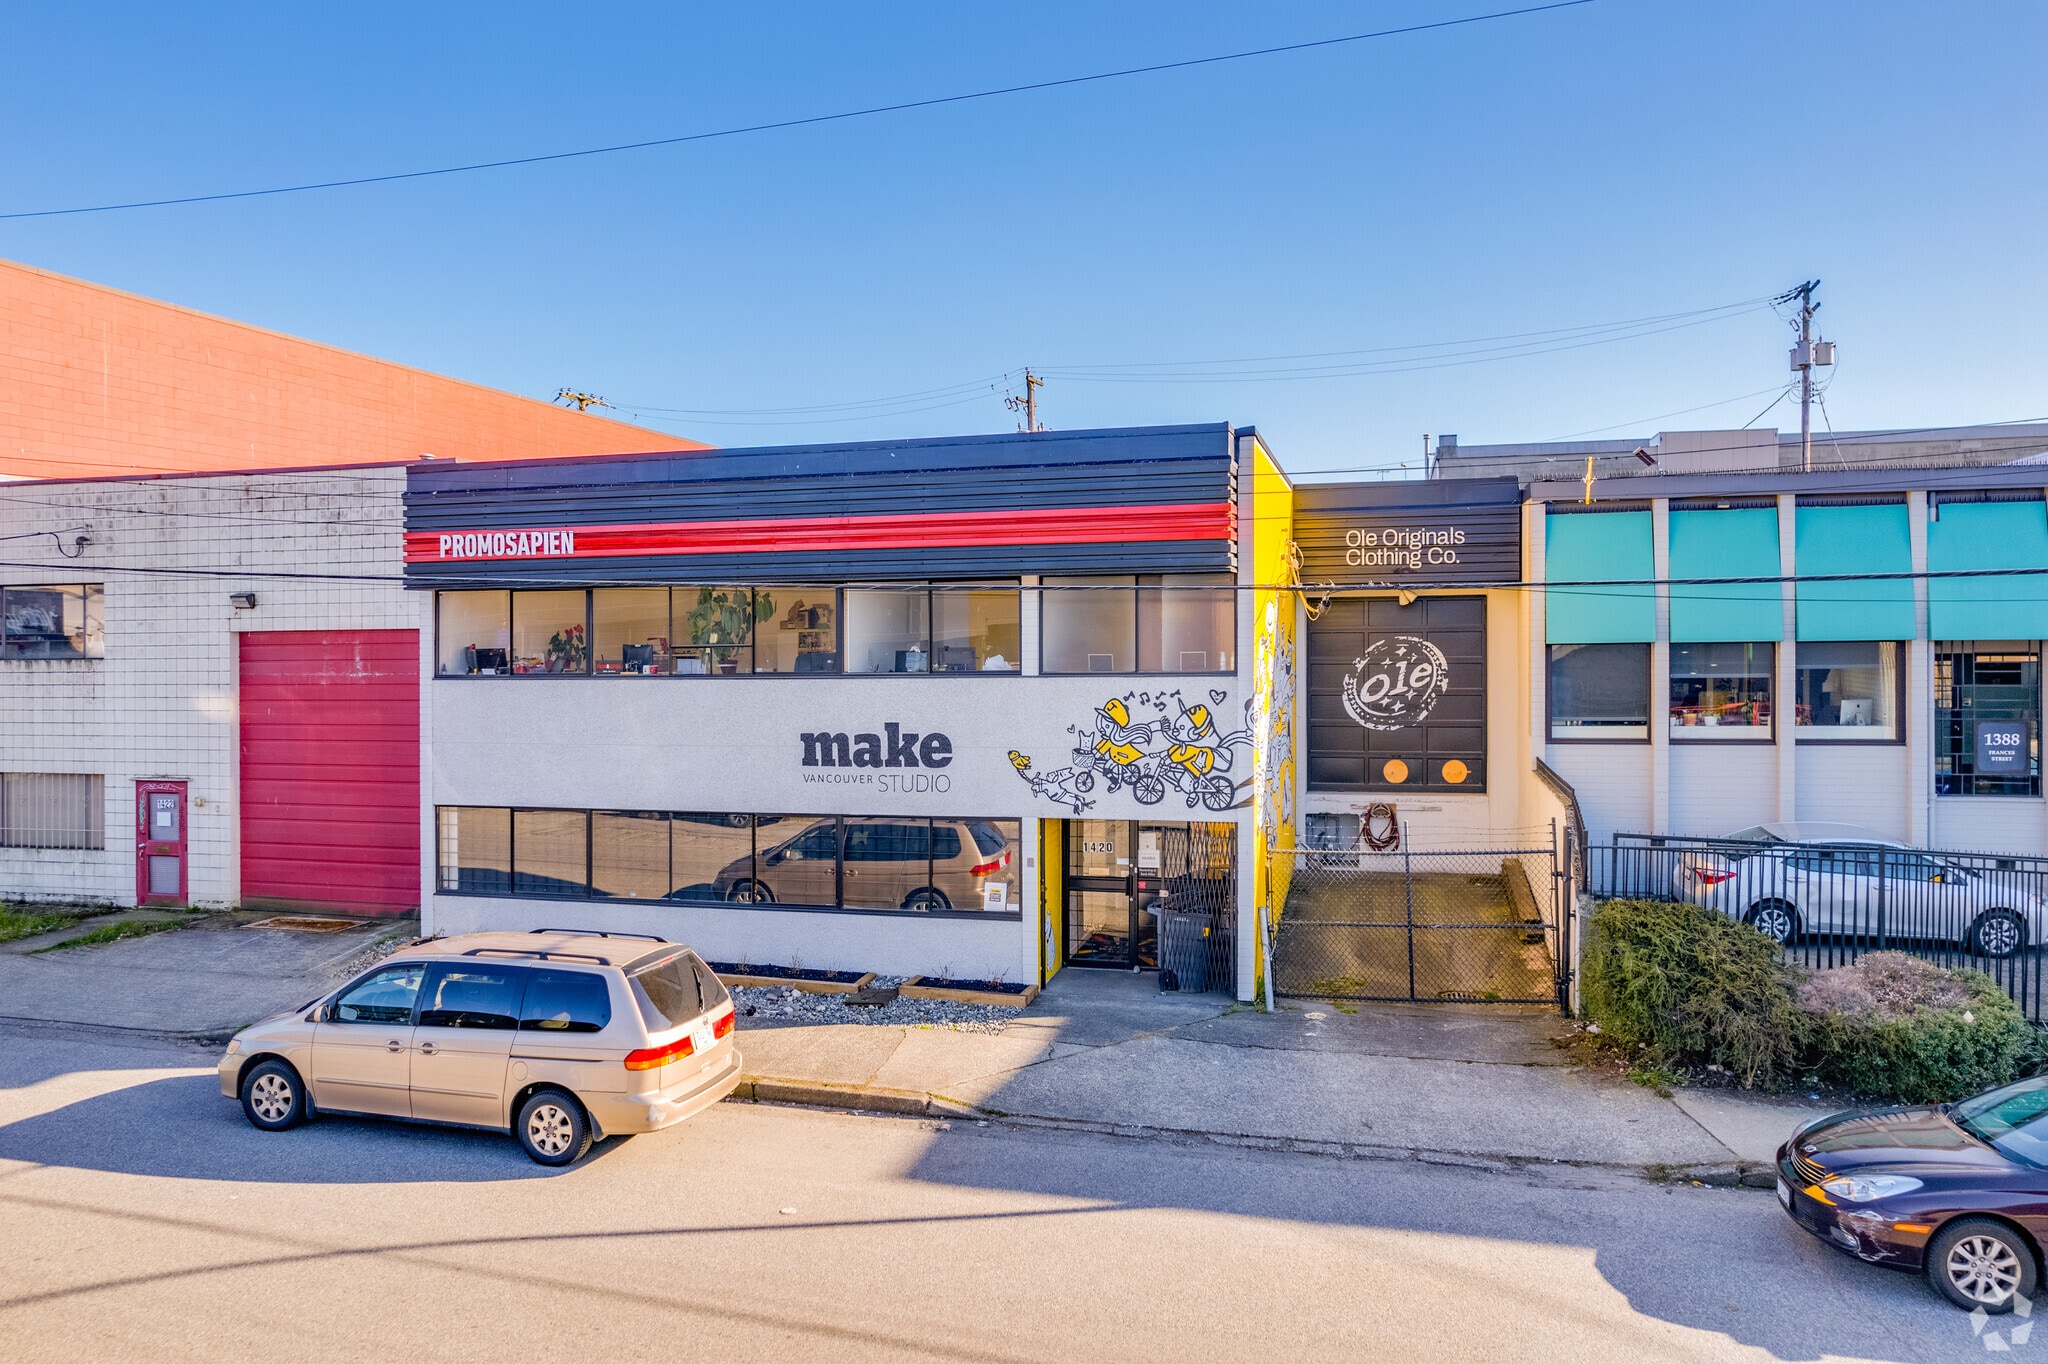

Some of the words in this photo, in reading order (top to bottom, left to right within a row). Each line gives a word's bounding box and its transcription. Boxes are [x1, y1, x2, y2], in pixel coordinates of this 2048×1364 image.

[439, 531, 574, 558] PROMOSAPIEN
[1346, 529, 1378, 547] Ole
[1382, 527, 1465, 550] Originals
[1346, 547, 1422, 569] Clothing
[1427, 547, 1460, 565] Co.
[800, 722, 953, 768] make
[1984, 733, 2020, 746] 1388
[802, 774, 873, 784] VANCOUVER
[878, 774, 951, 793] STUDIO
[1083, 841, 1114, 853] 1420
